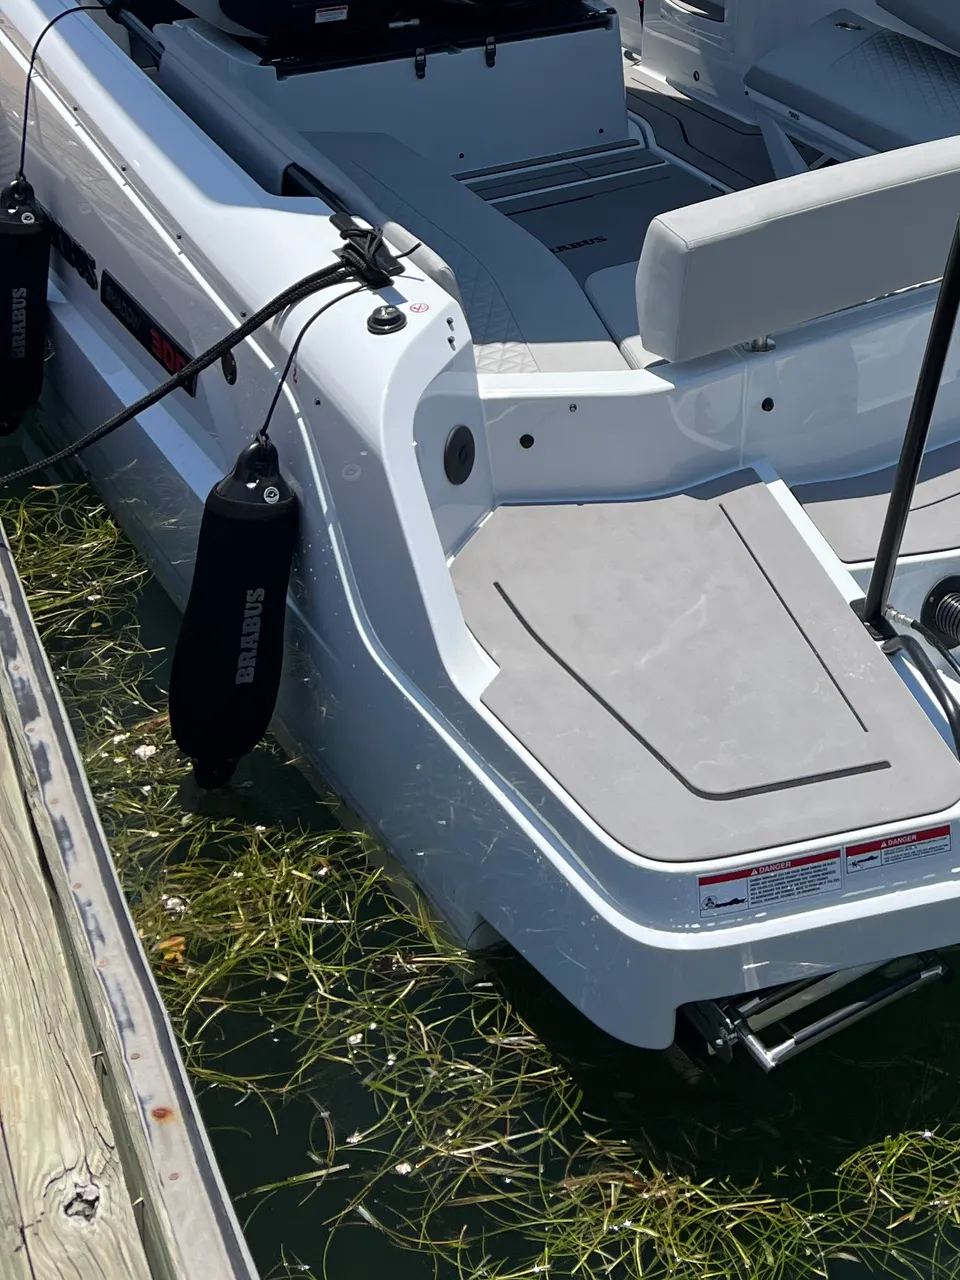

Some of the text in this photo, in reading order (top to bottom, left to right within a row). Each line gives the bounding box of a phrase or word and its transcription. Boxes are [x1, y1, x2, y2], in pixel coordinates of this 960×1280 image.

[12, 287, 27, 359] BRABUS
[235, 587, 265, 685] BRABUS
[887, 834, 917, 846] DANGER
[759, 861, 792, 874] DANGER
